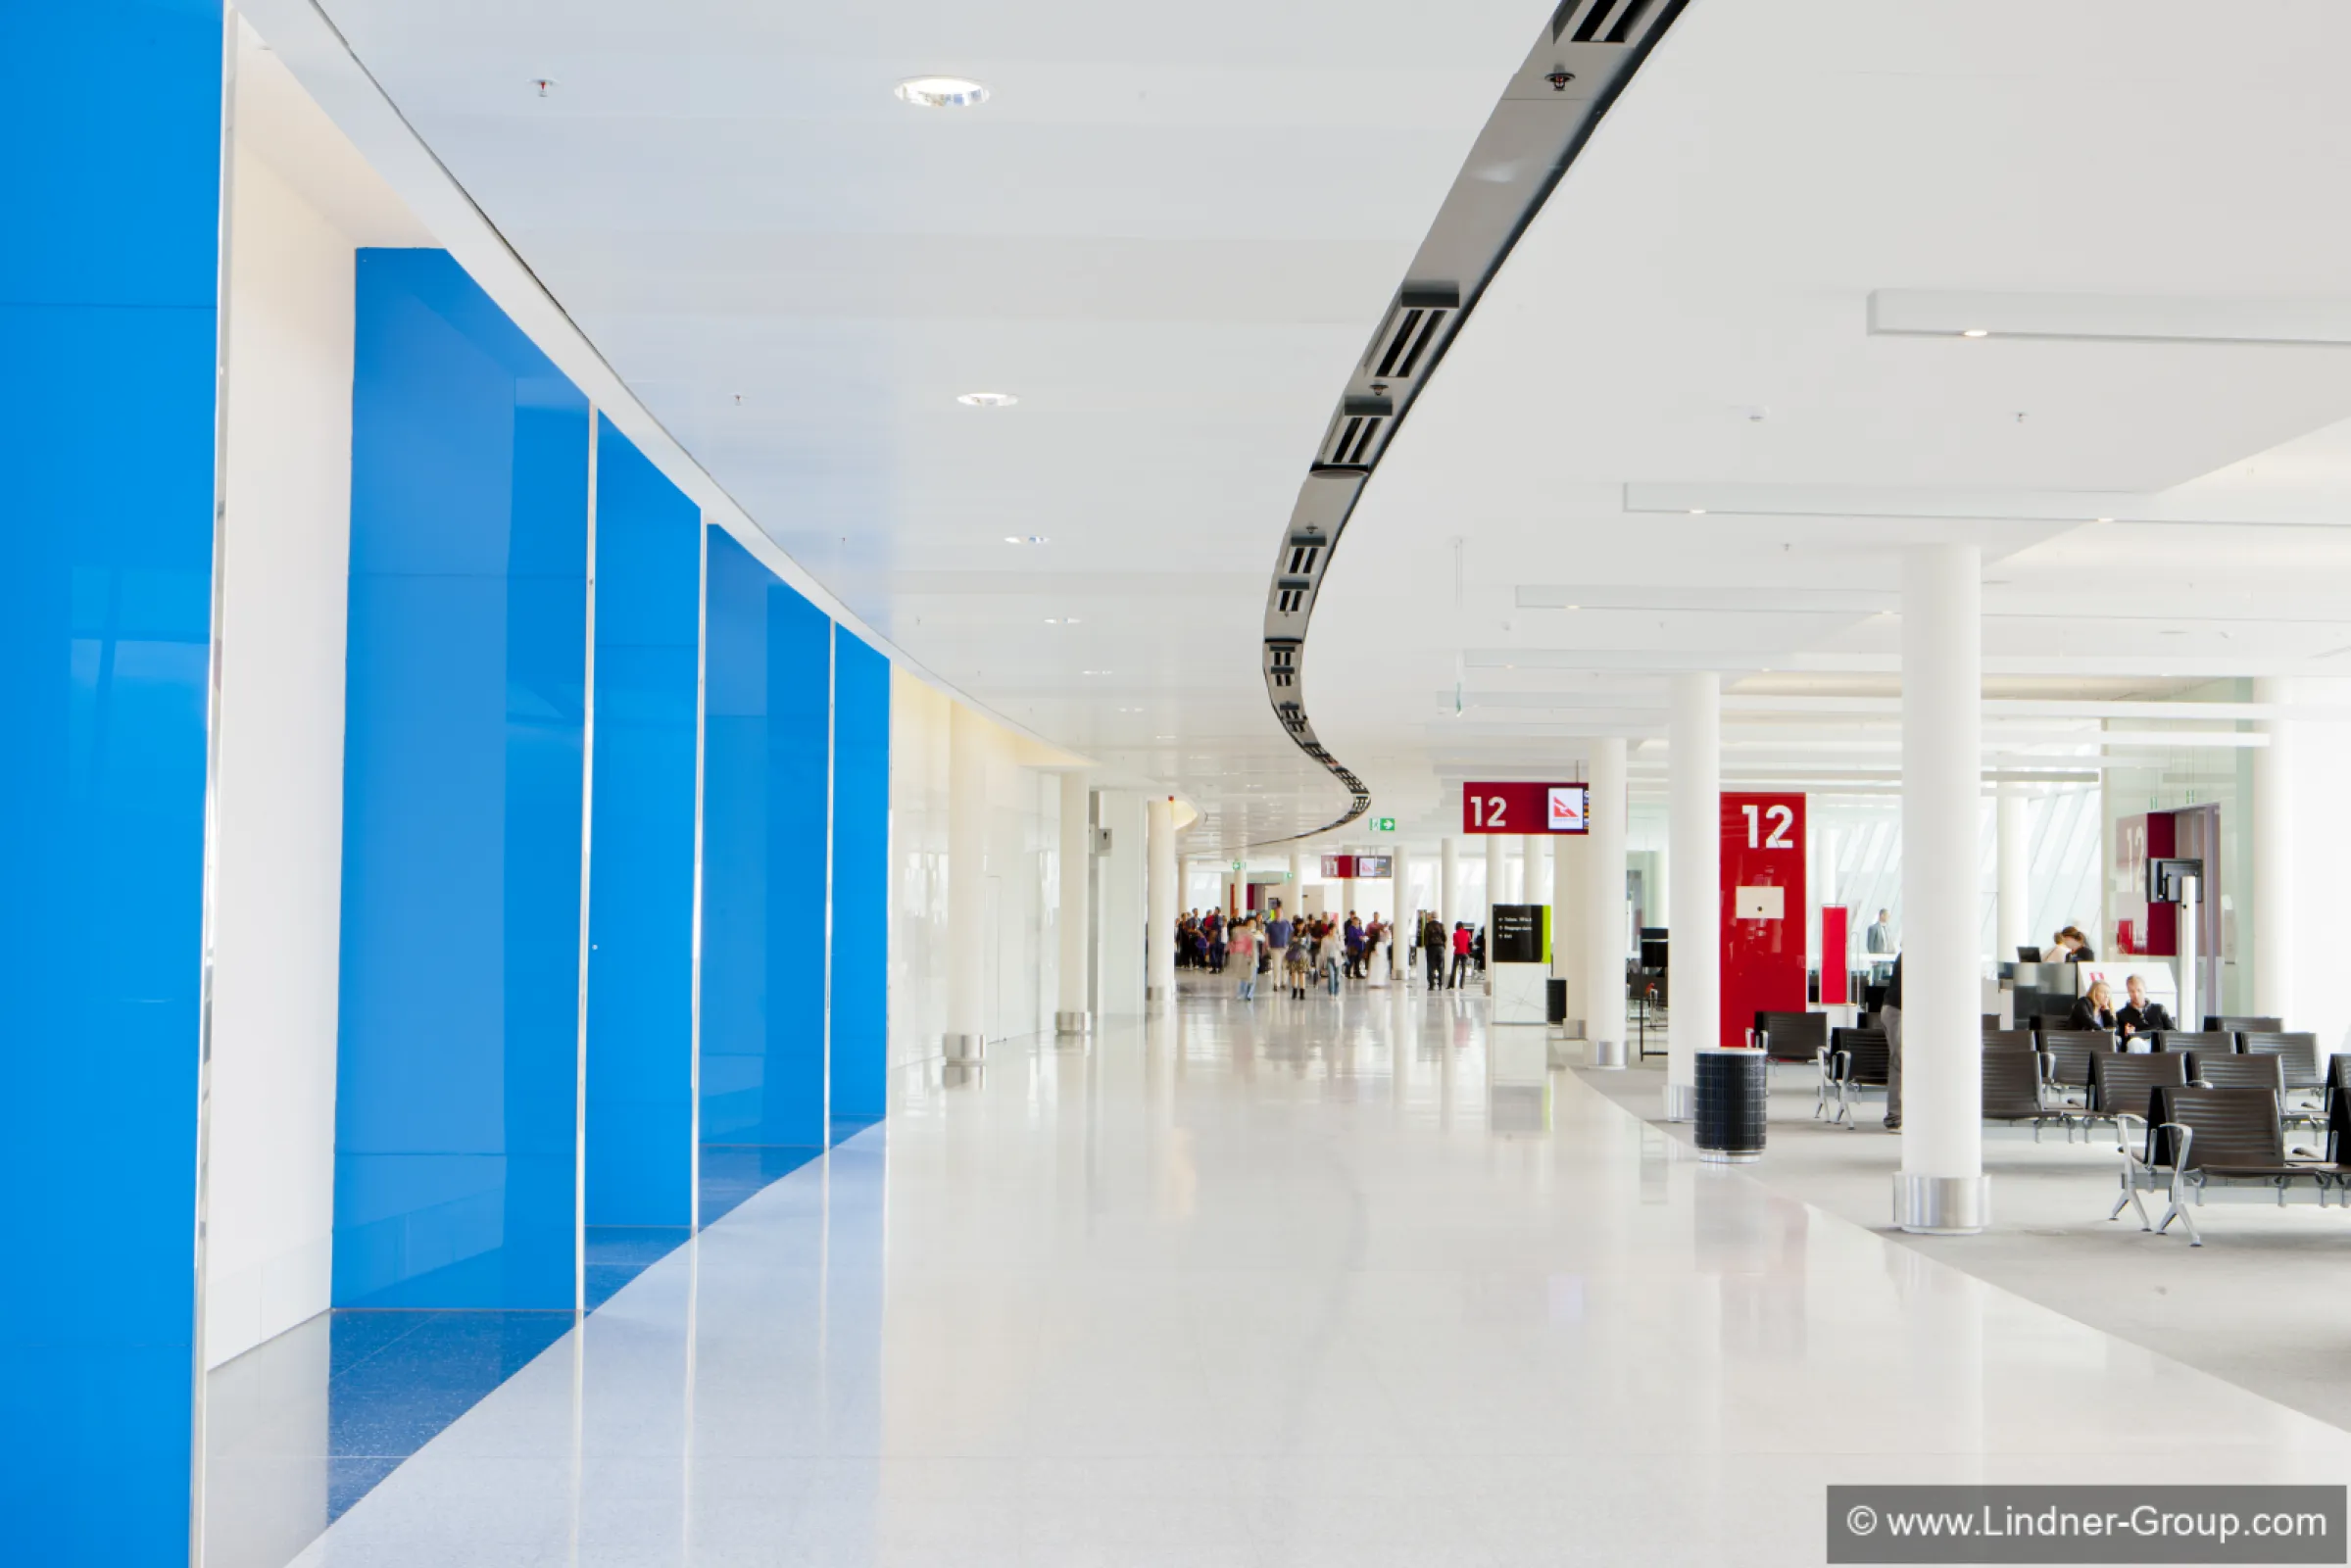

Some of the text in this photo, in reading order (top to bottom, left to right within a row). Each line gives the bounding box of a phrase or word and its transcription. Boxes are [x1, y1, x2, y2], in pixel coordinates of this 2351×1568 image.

[1470, 796, 1507, 827] 12
[1741, 804, 1794, 849] 12
[1325, 860, 1338, 875] 11
[2127, 825, 2145, 893] 12
